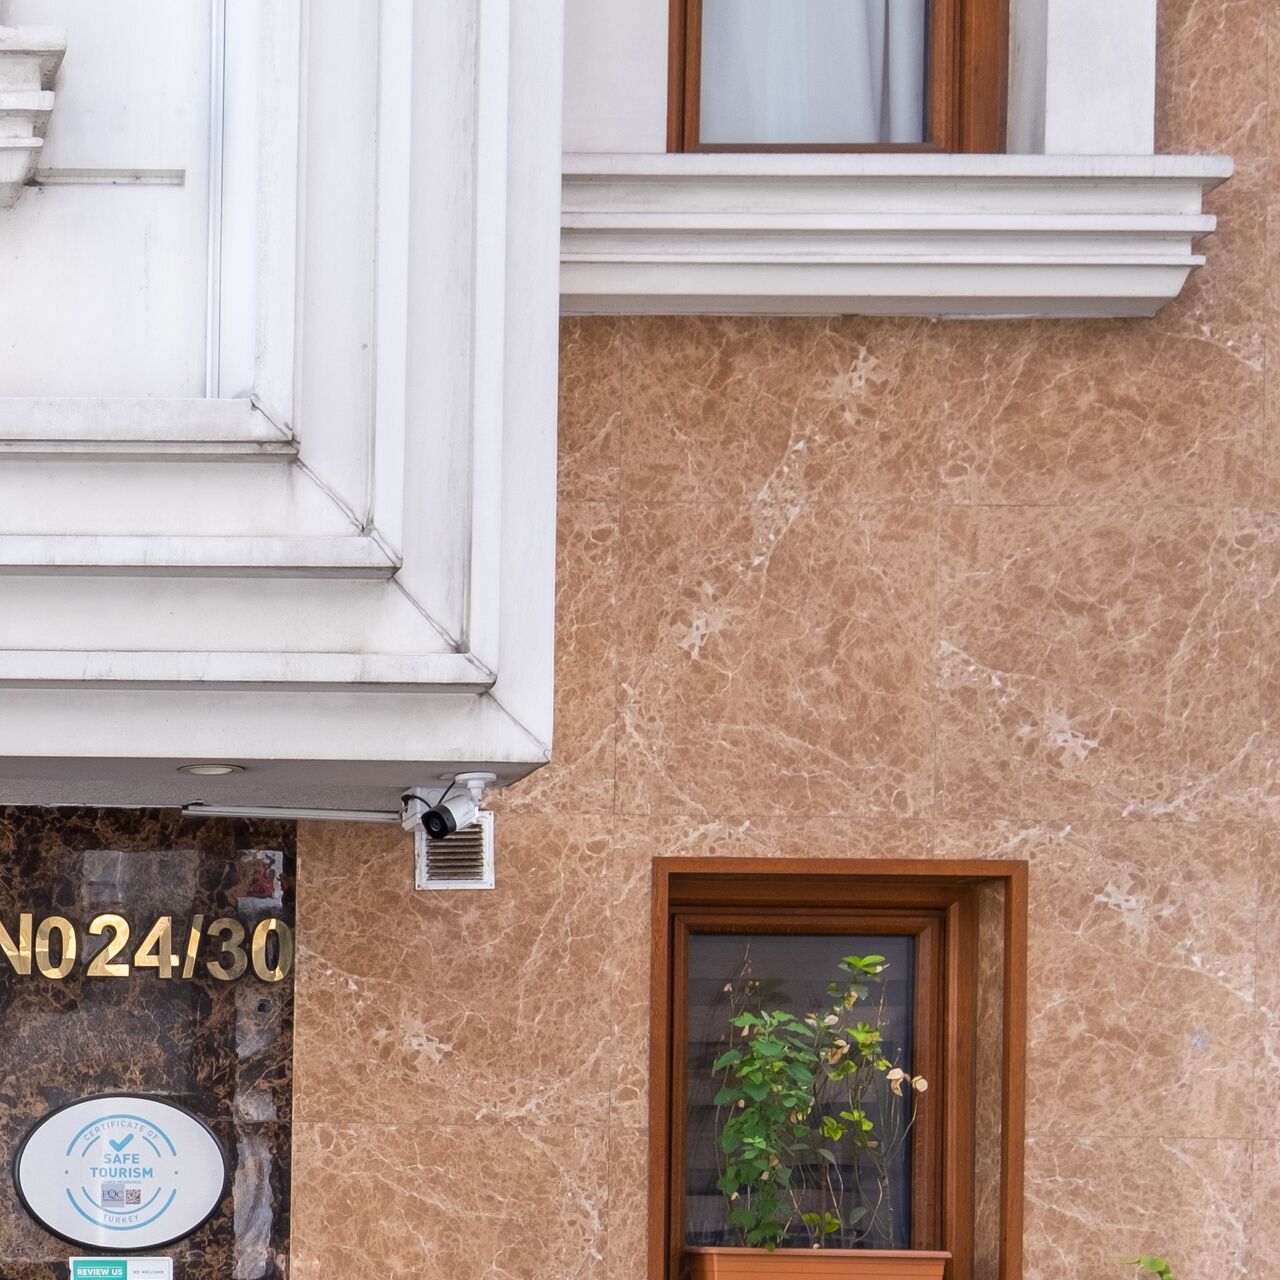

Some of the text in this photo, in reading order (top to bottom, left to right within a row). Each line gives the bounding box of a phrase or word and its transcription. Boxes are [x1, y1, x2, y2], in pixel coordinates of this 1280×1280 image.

[83, 1120, 160, 1142] CERTIFICATE OF
[103, 1153, 140, 1164] SAFE
[90, 1167, 154, 1179] TOURISM
[103, 1213, 140, 1224] TURKEY
[76, 1268, 123, 1276] REVIEW US
